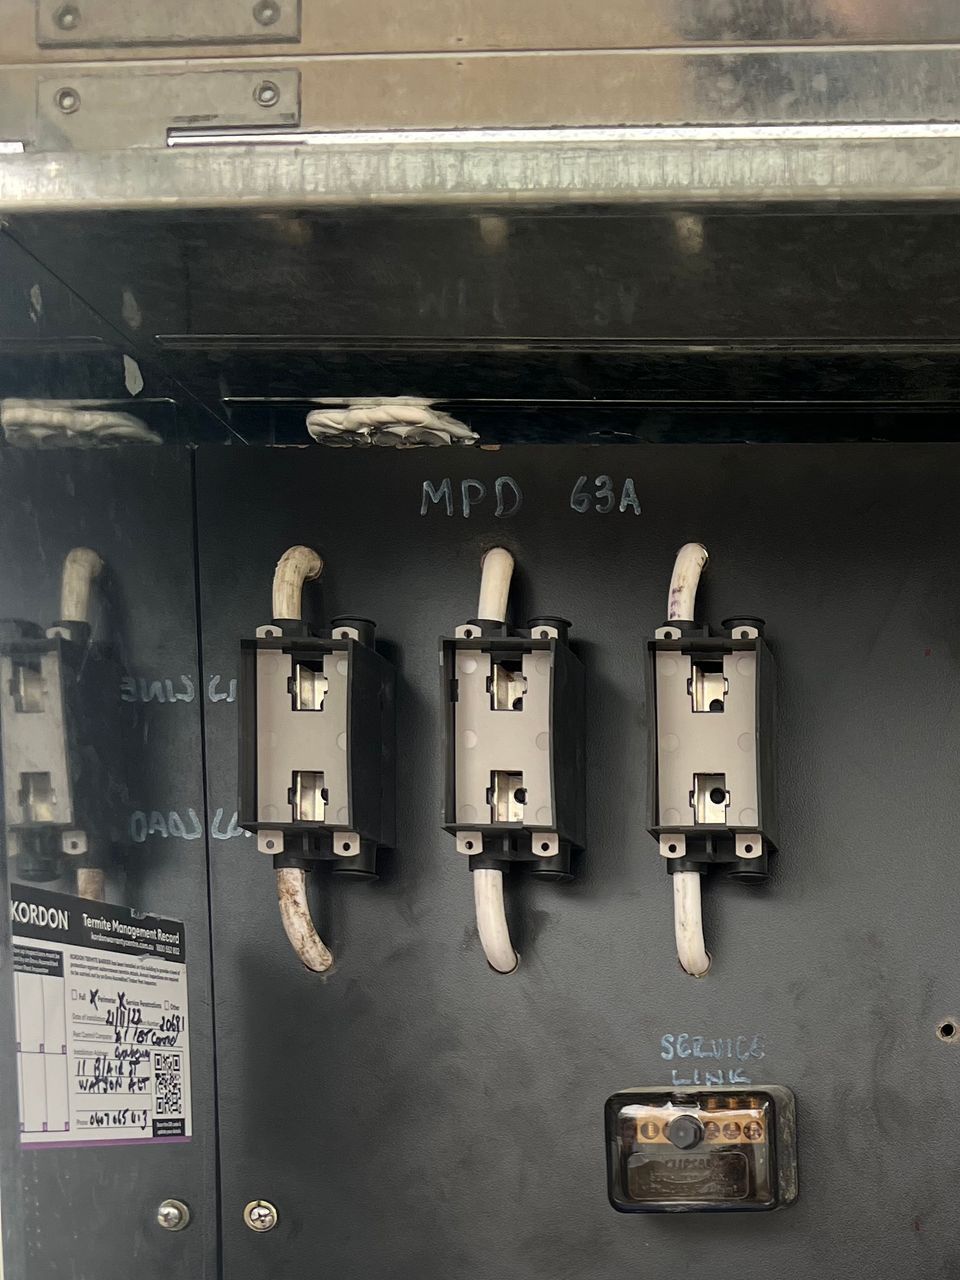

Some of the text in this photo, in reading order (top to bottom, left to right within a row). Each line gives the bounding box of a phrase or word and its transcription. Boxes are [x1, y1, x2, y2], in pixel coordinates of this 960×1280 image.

[420, 475, 642, 519] MPD 63A
[11, 900, 69, 930] KORDON
[82, 913, 180, 944] Termite Management Record
[660, 1032, 765, 1060] SERVICE
[672, 1069, 750, 1086] LINK
